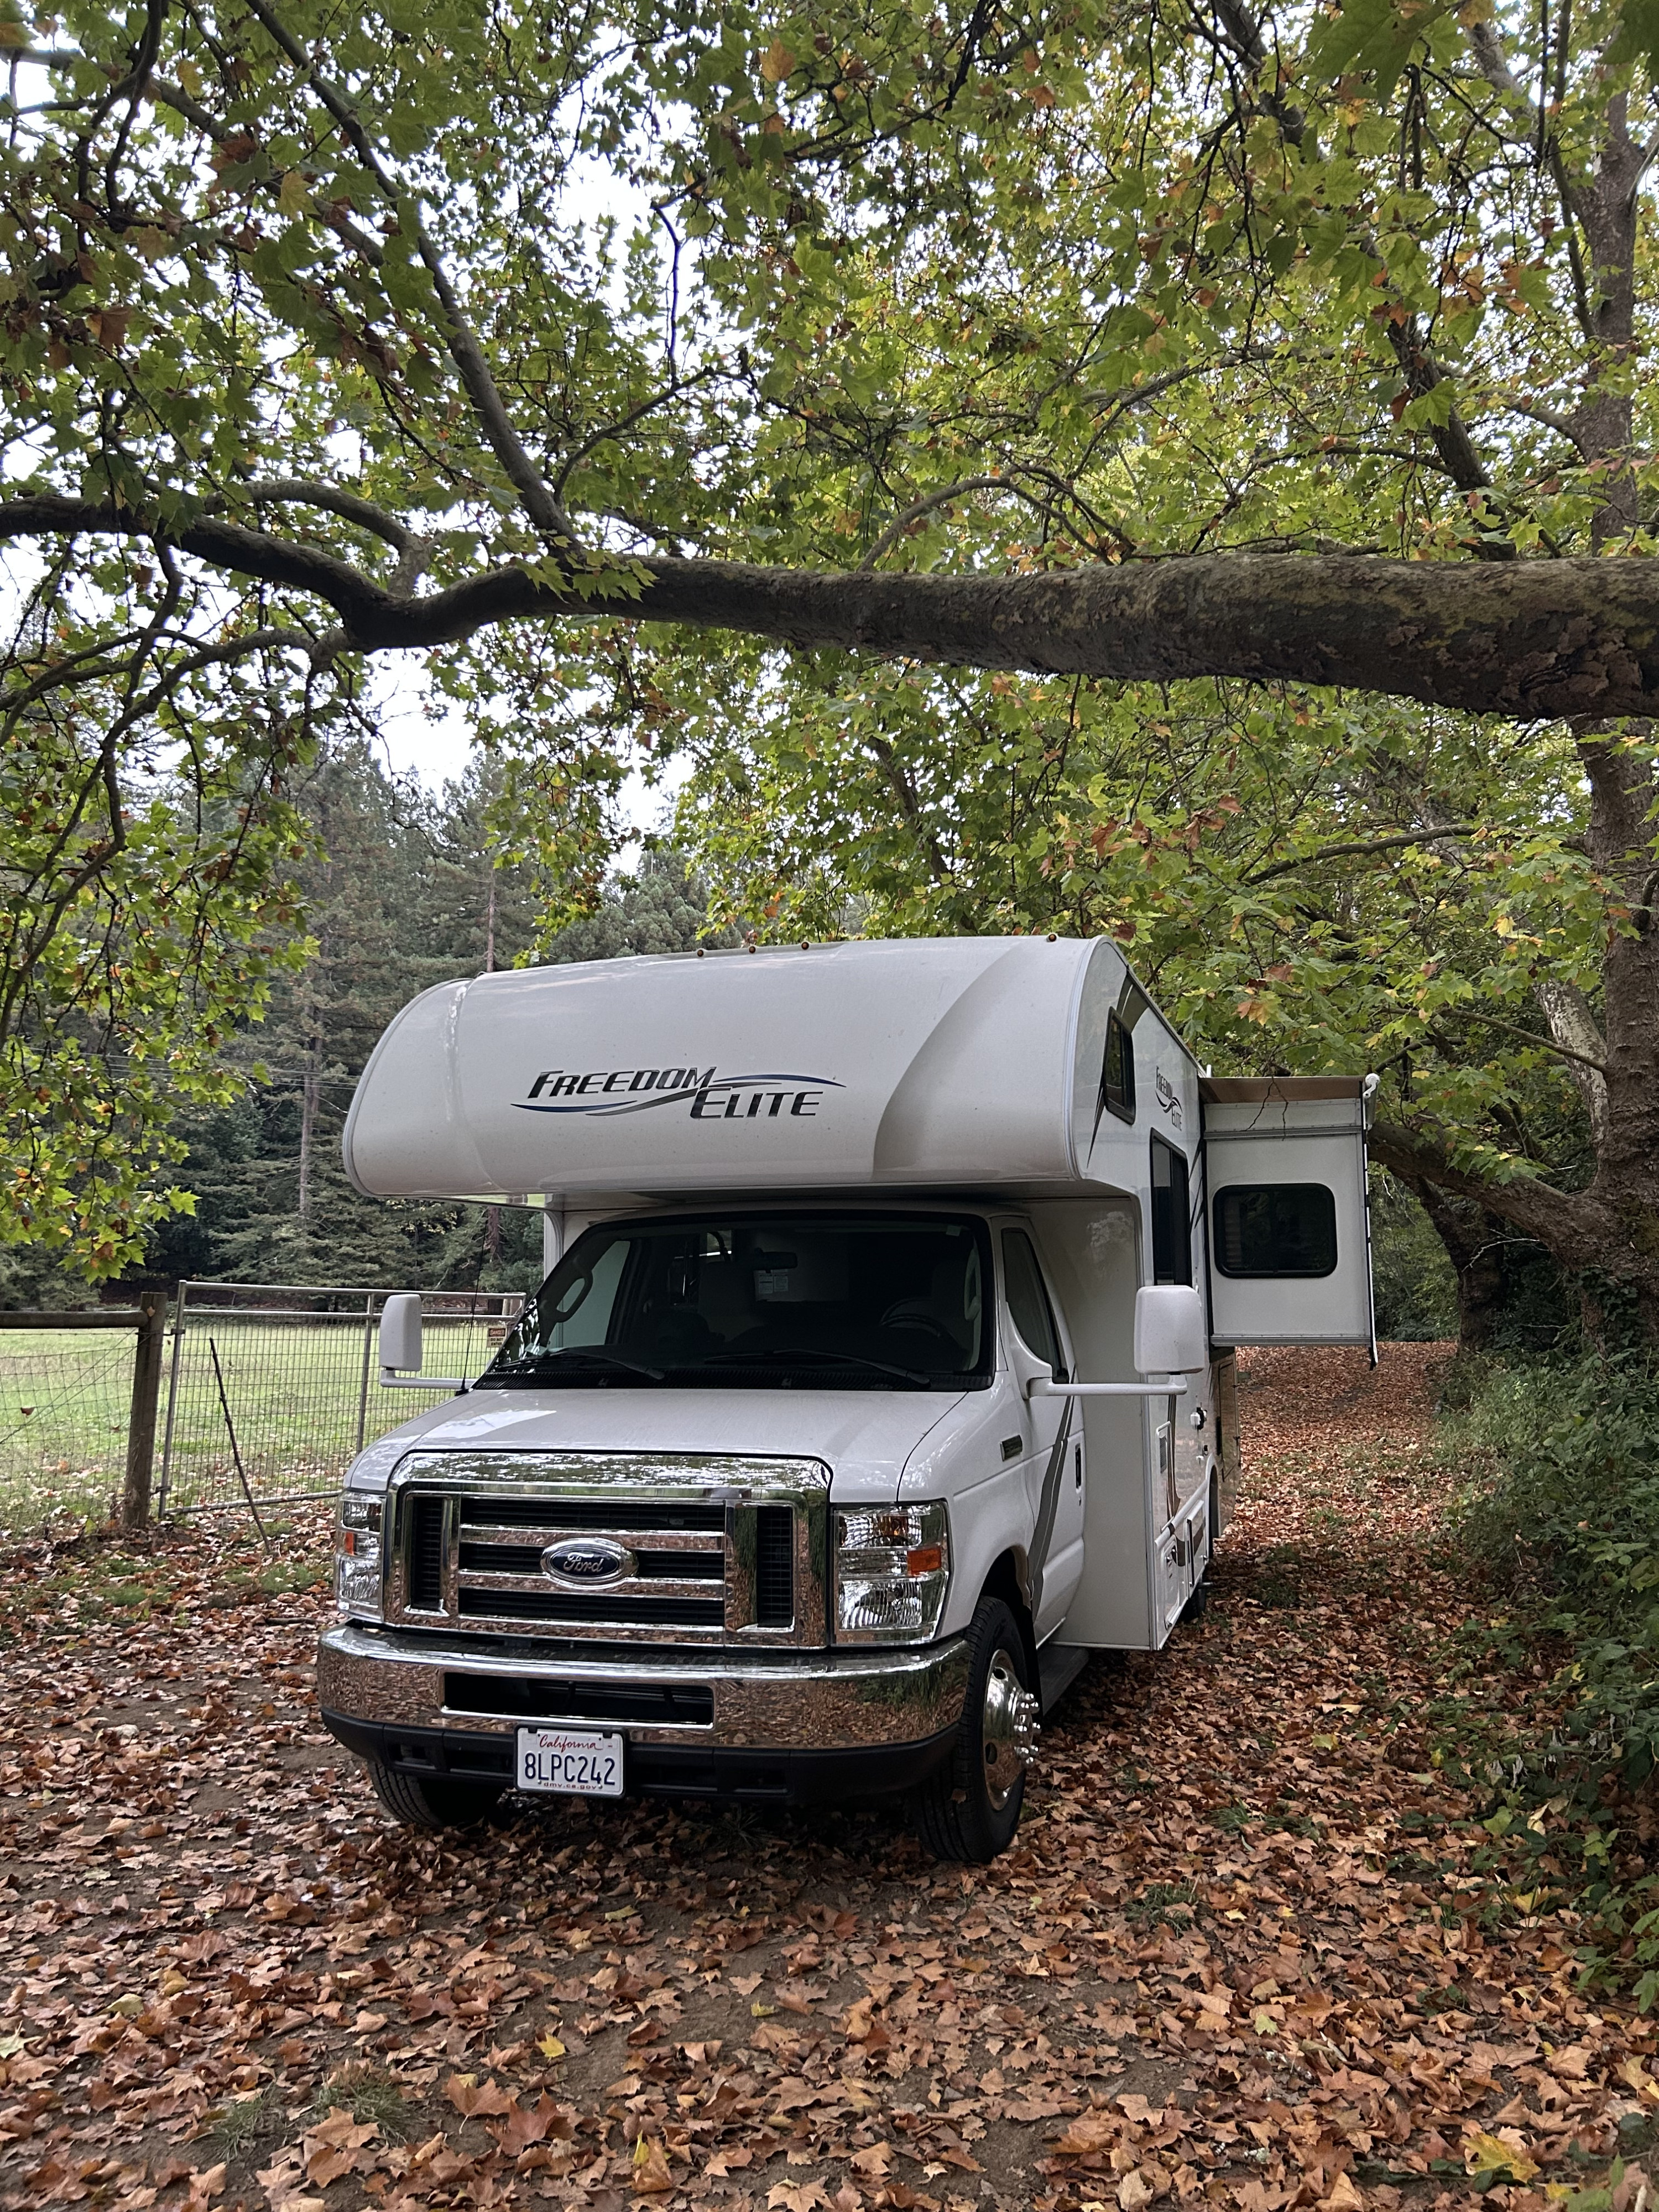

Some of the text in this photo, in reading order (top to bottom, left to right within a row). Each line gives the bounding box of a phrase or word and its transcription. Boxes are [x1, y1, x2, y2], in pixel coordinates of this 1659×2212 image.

[528, 1067, 717, 1099] FREEDOM
[690, 1087, 824, 1119] ELITE
[563, 1552, 604, 1573] Ford
[539, 1734, 603, 1753] California
[525, 1752, 615, 1785] 8LPC242
[544, 1782, 597, 1790] dmv.ca.gov
